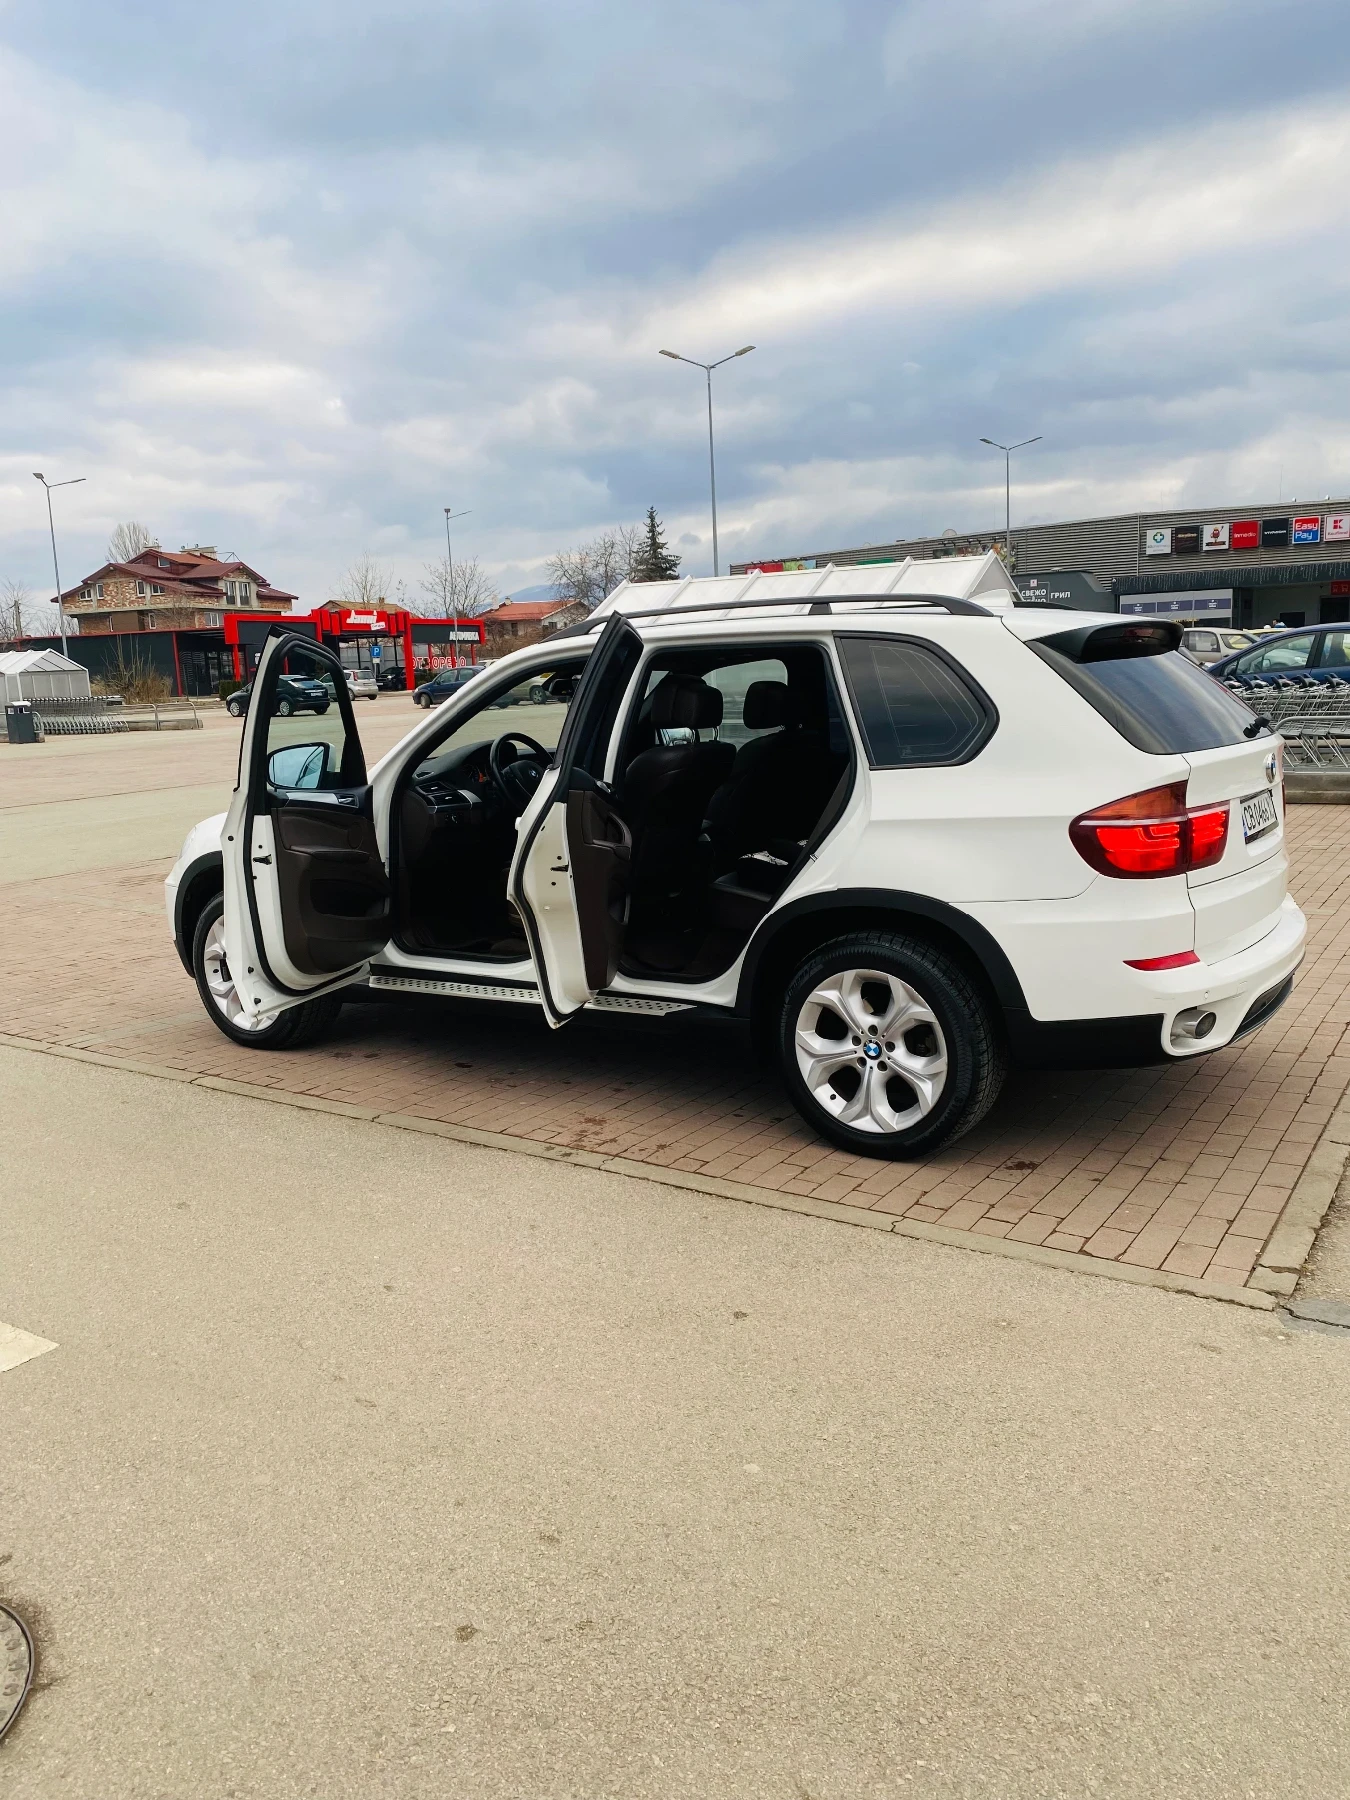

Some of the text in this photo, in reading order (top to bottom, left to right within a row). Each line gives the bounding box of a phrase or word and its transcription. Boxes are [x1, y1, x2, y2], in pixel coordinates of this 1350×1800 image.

[1295, 522, 1318, 530] Easy
[1295, 531, 1312, 540] Pay
[1050, 591, 1071, 599] ГРИЛ
